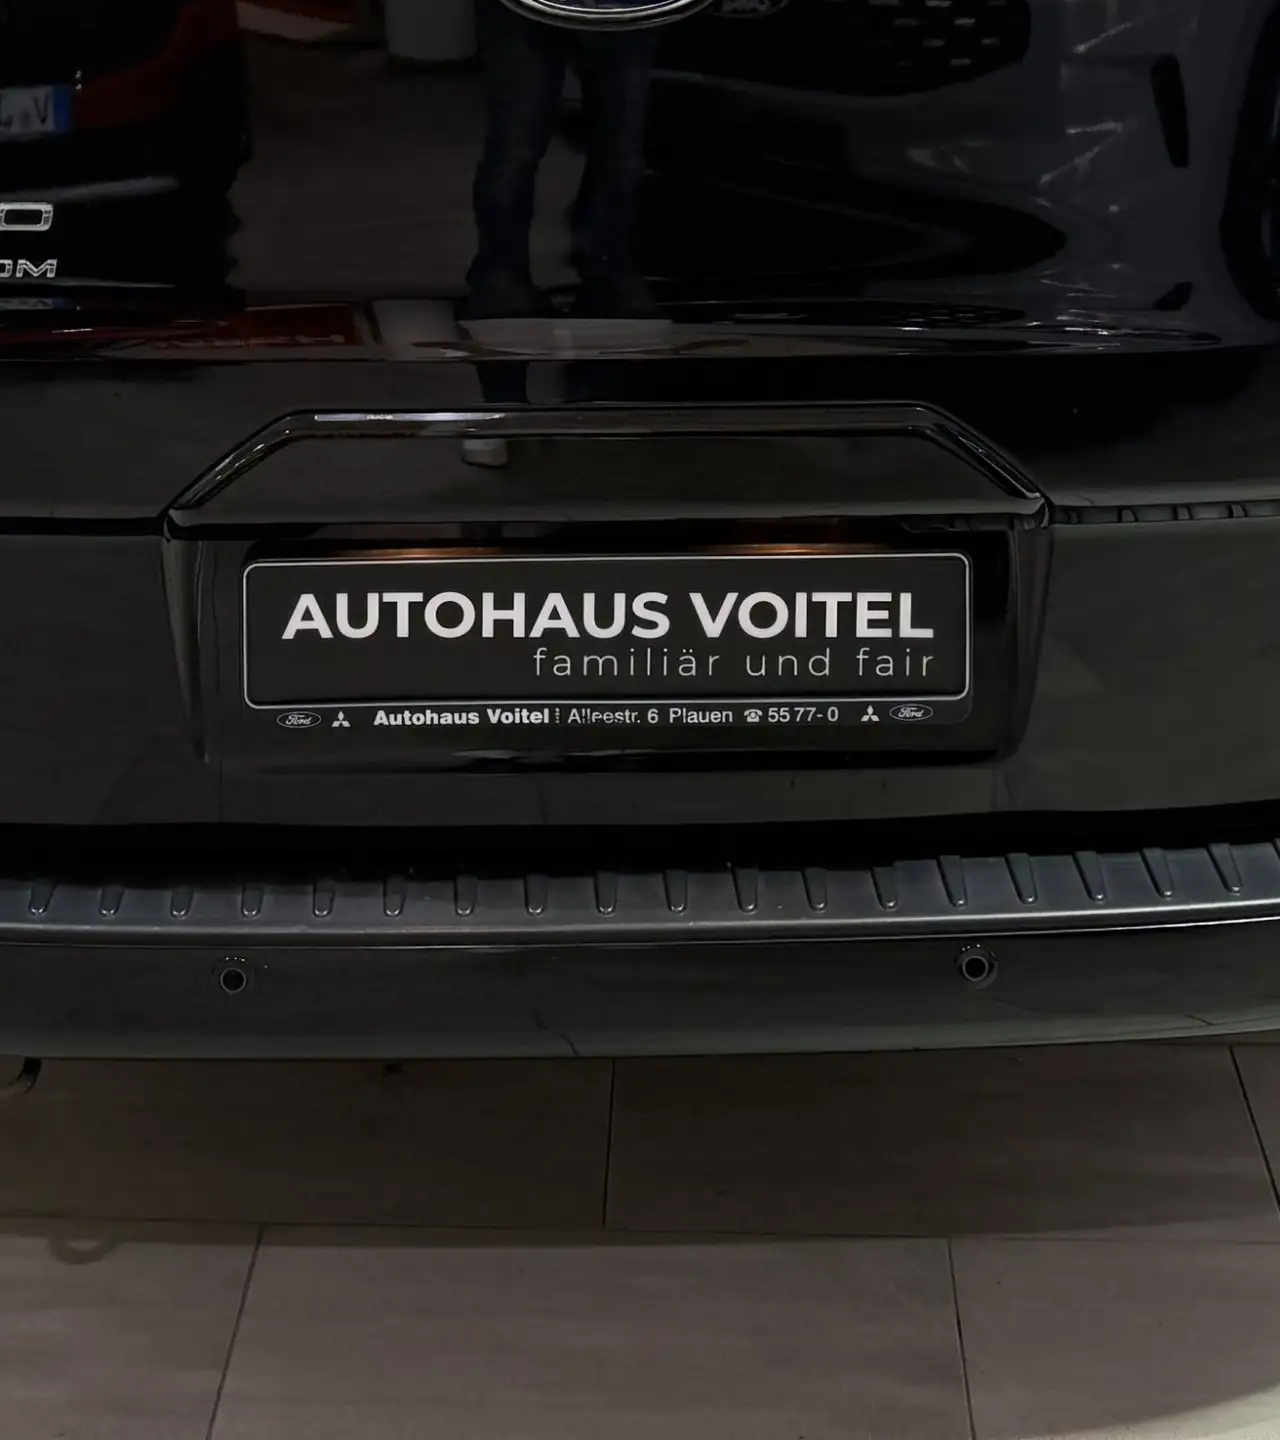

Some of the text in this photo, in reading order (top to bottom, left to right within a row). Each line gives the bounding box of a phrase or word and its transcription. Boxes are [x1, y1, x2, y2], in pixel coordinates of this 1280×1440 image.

[282, 591, 934, 641] AUTOHAUS VOITEL
[534, 646, 934, 677] familiär und fair
[374, 709, 480, 726] Autohaus
[486, 708, 548, 724] Voitel
[647, 708, 659, 724] 6
[669, 707, 733, 723] Plauen
